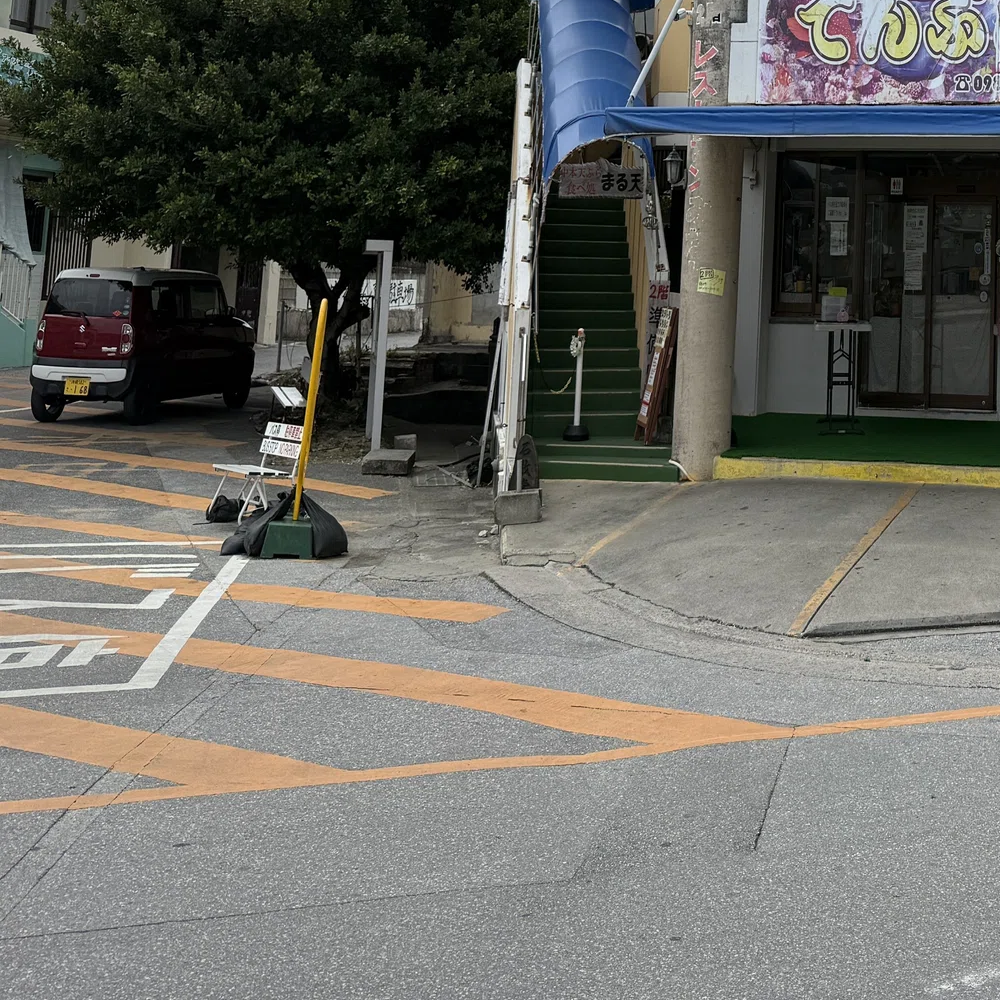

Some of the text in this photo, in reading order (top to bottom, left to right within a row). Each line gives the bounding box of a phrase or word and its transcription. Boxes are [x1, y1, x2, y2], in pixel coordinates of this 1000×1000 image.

[601, 172, 642, 193] まる天
[649, 284, 669, 299] 2階
